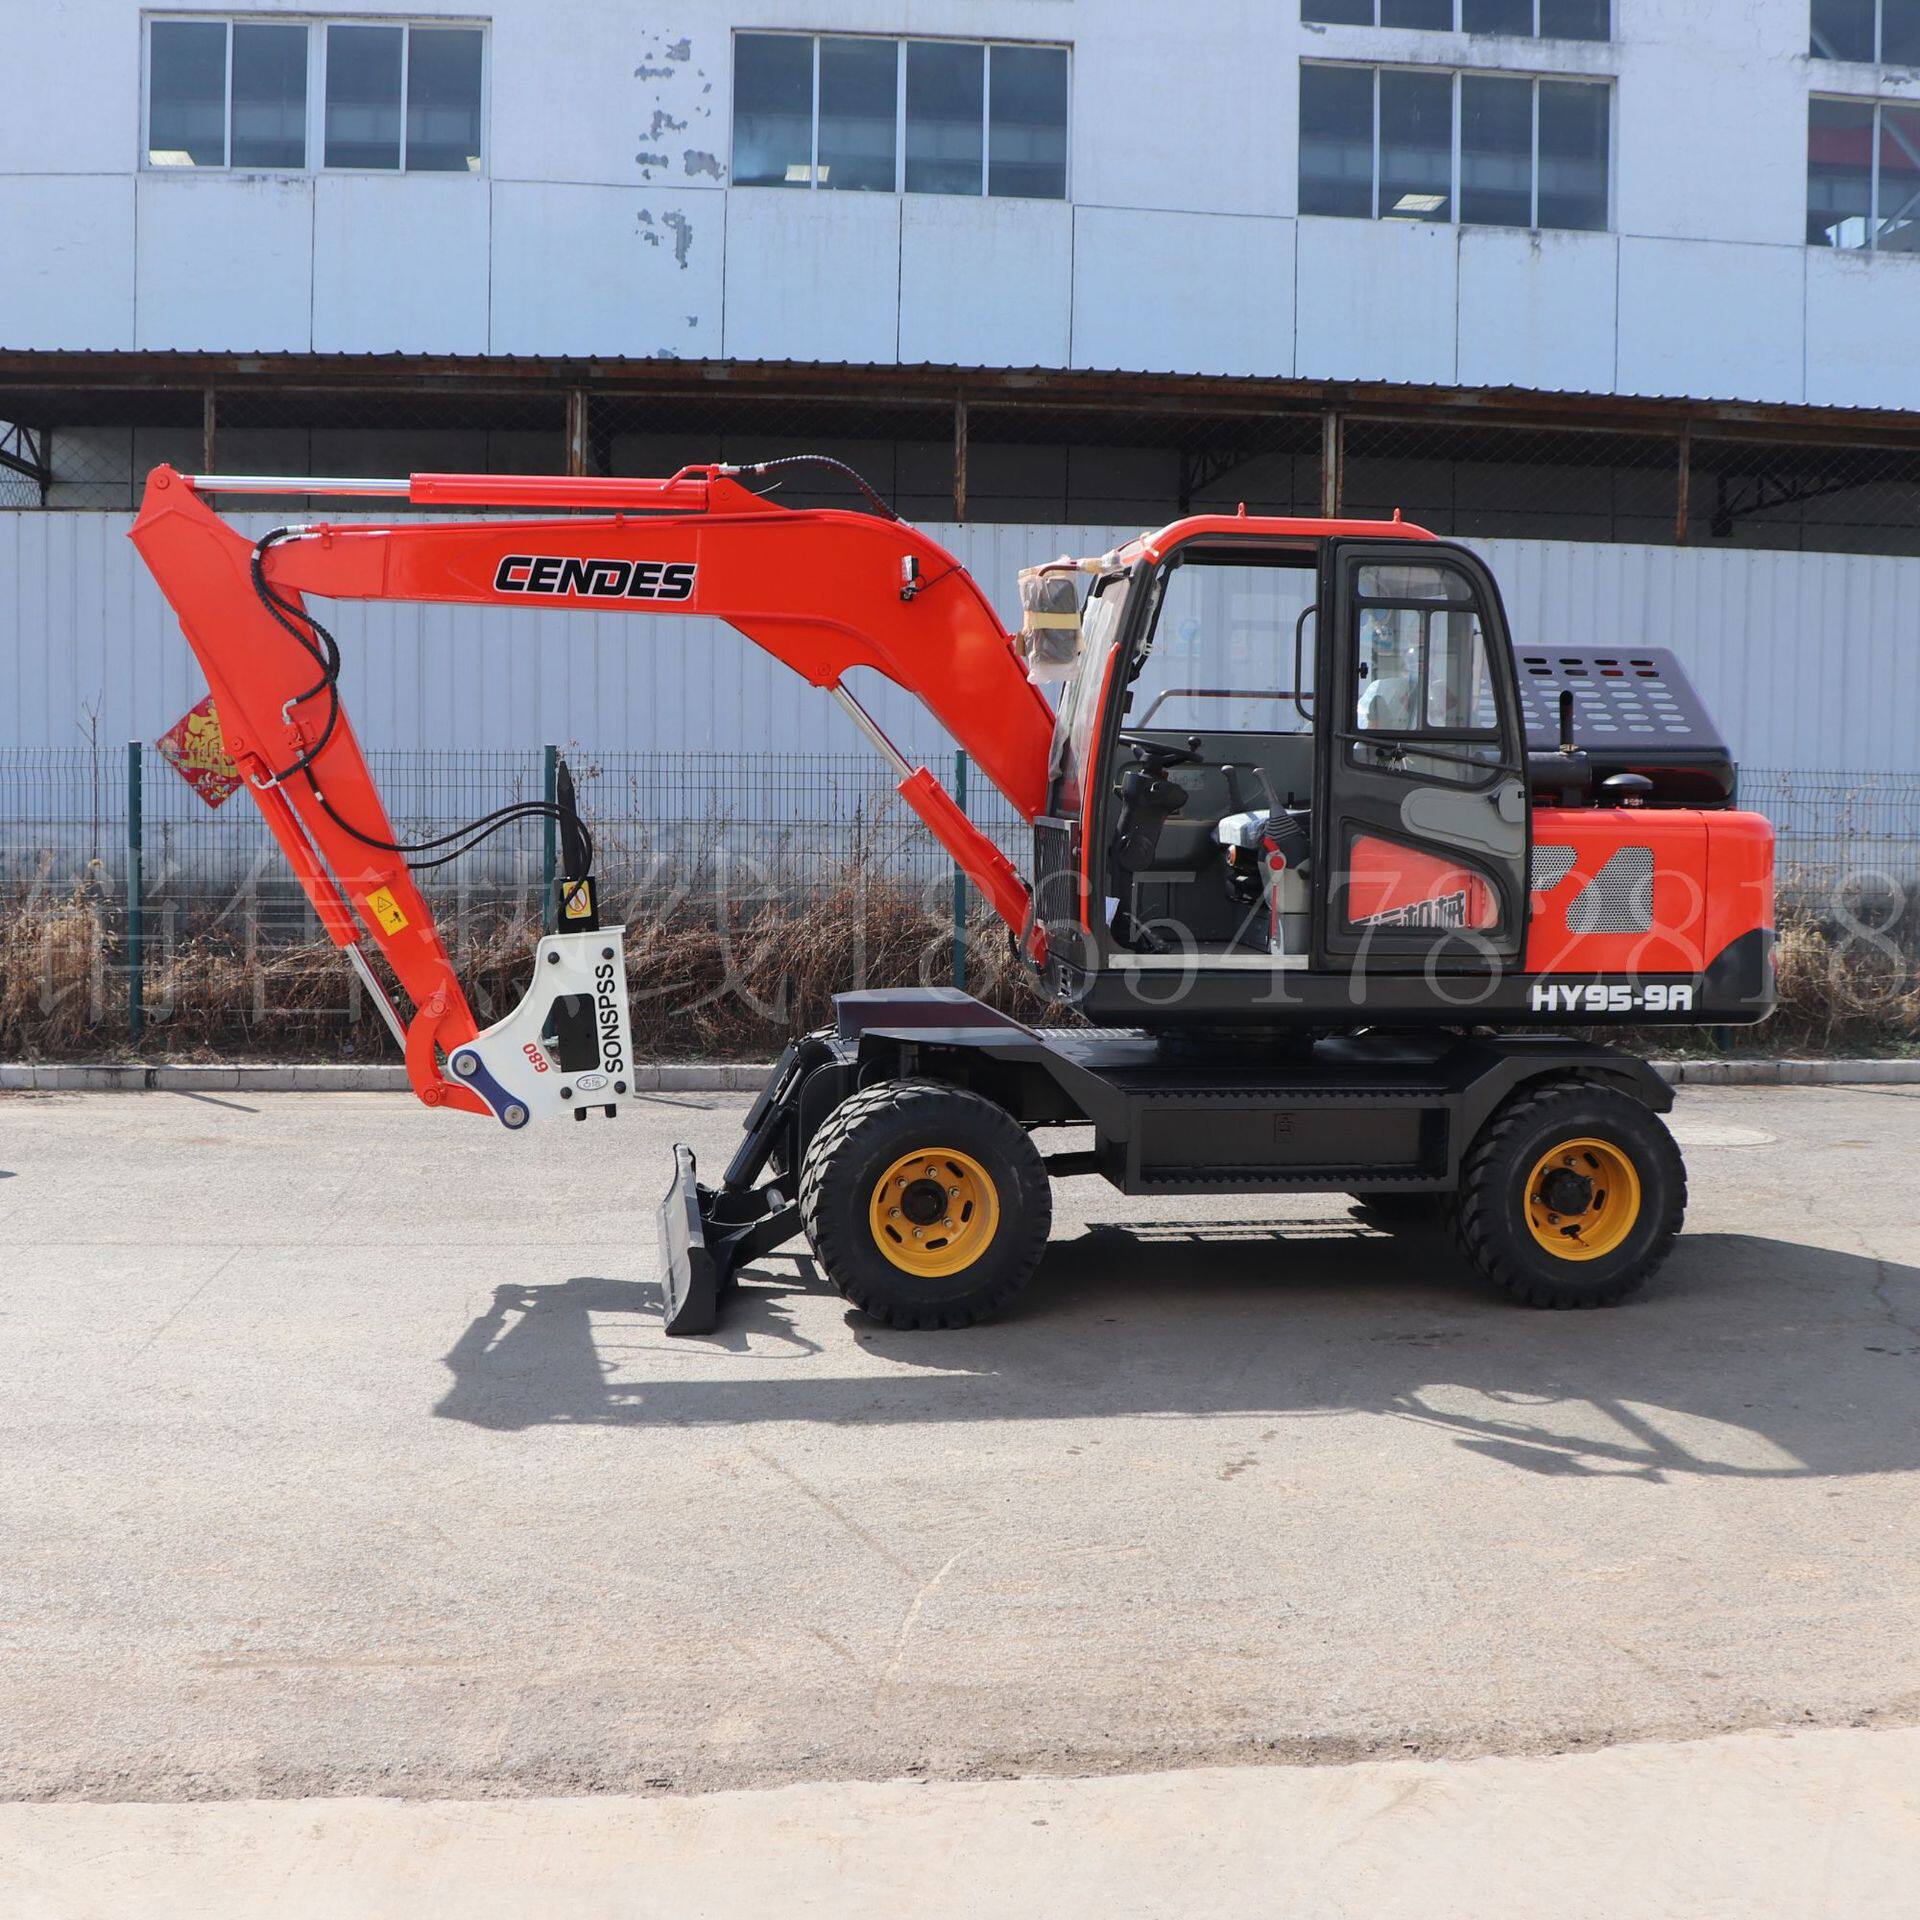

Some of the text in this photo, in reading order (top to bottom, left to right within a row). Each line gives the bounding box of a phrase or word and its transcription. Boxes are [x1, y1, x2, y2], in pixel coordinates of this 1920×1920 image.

[493, 554, 698, 601] CENDES
[1531, 984, 1693, 1012] HY95-9A
[595, 963, 624, 1074] SONSPSS
[522, 1042, 549, 1074] 680
